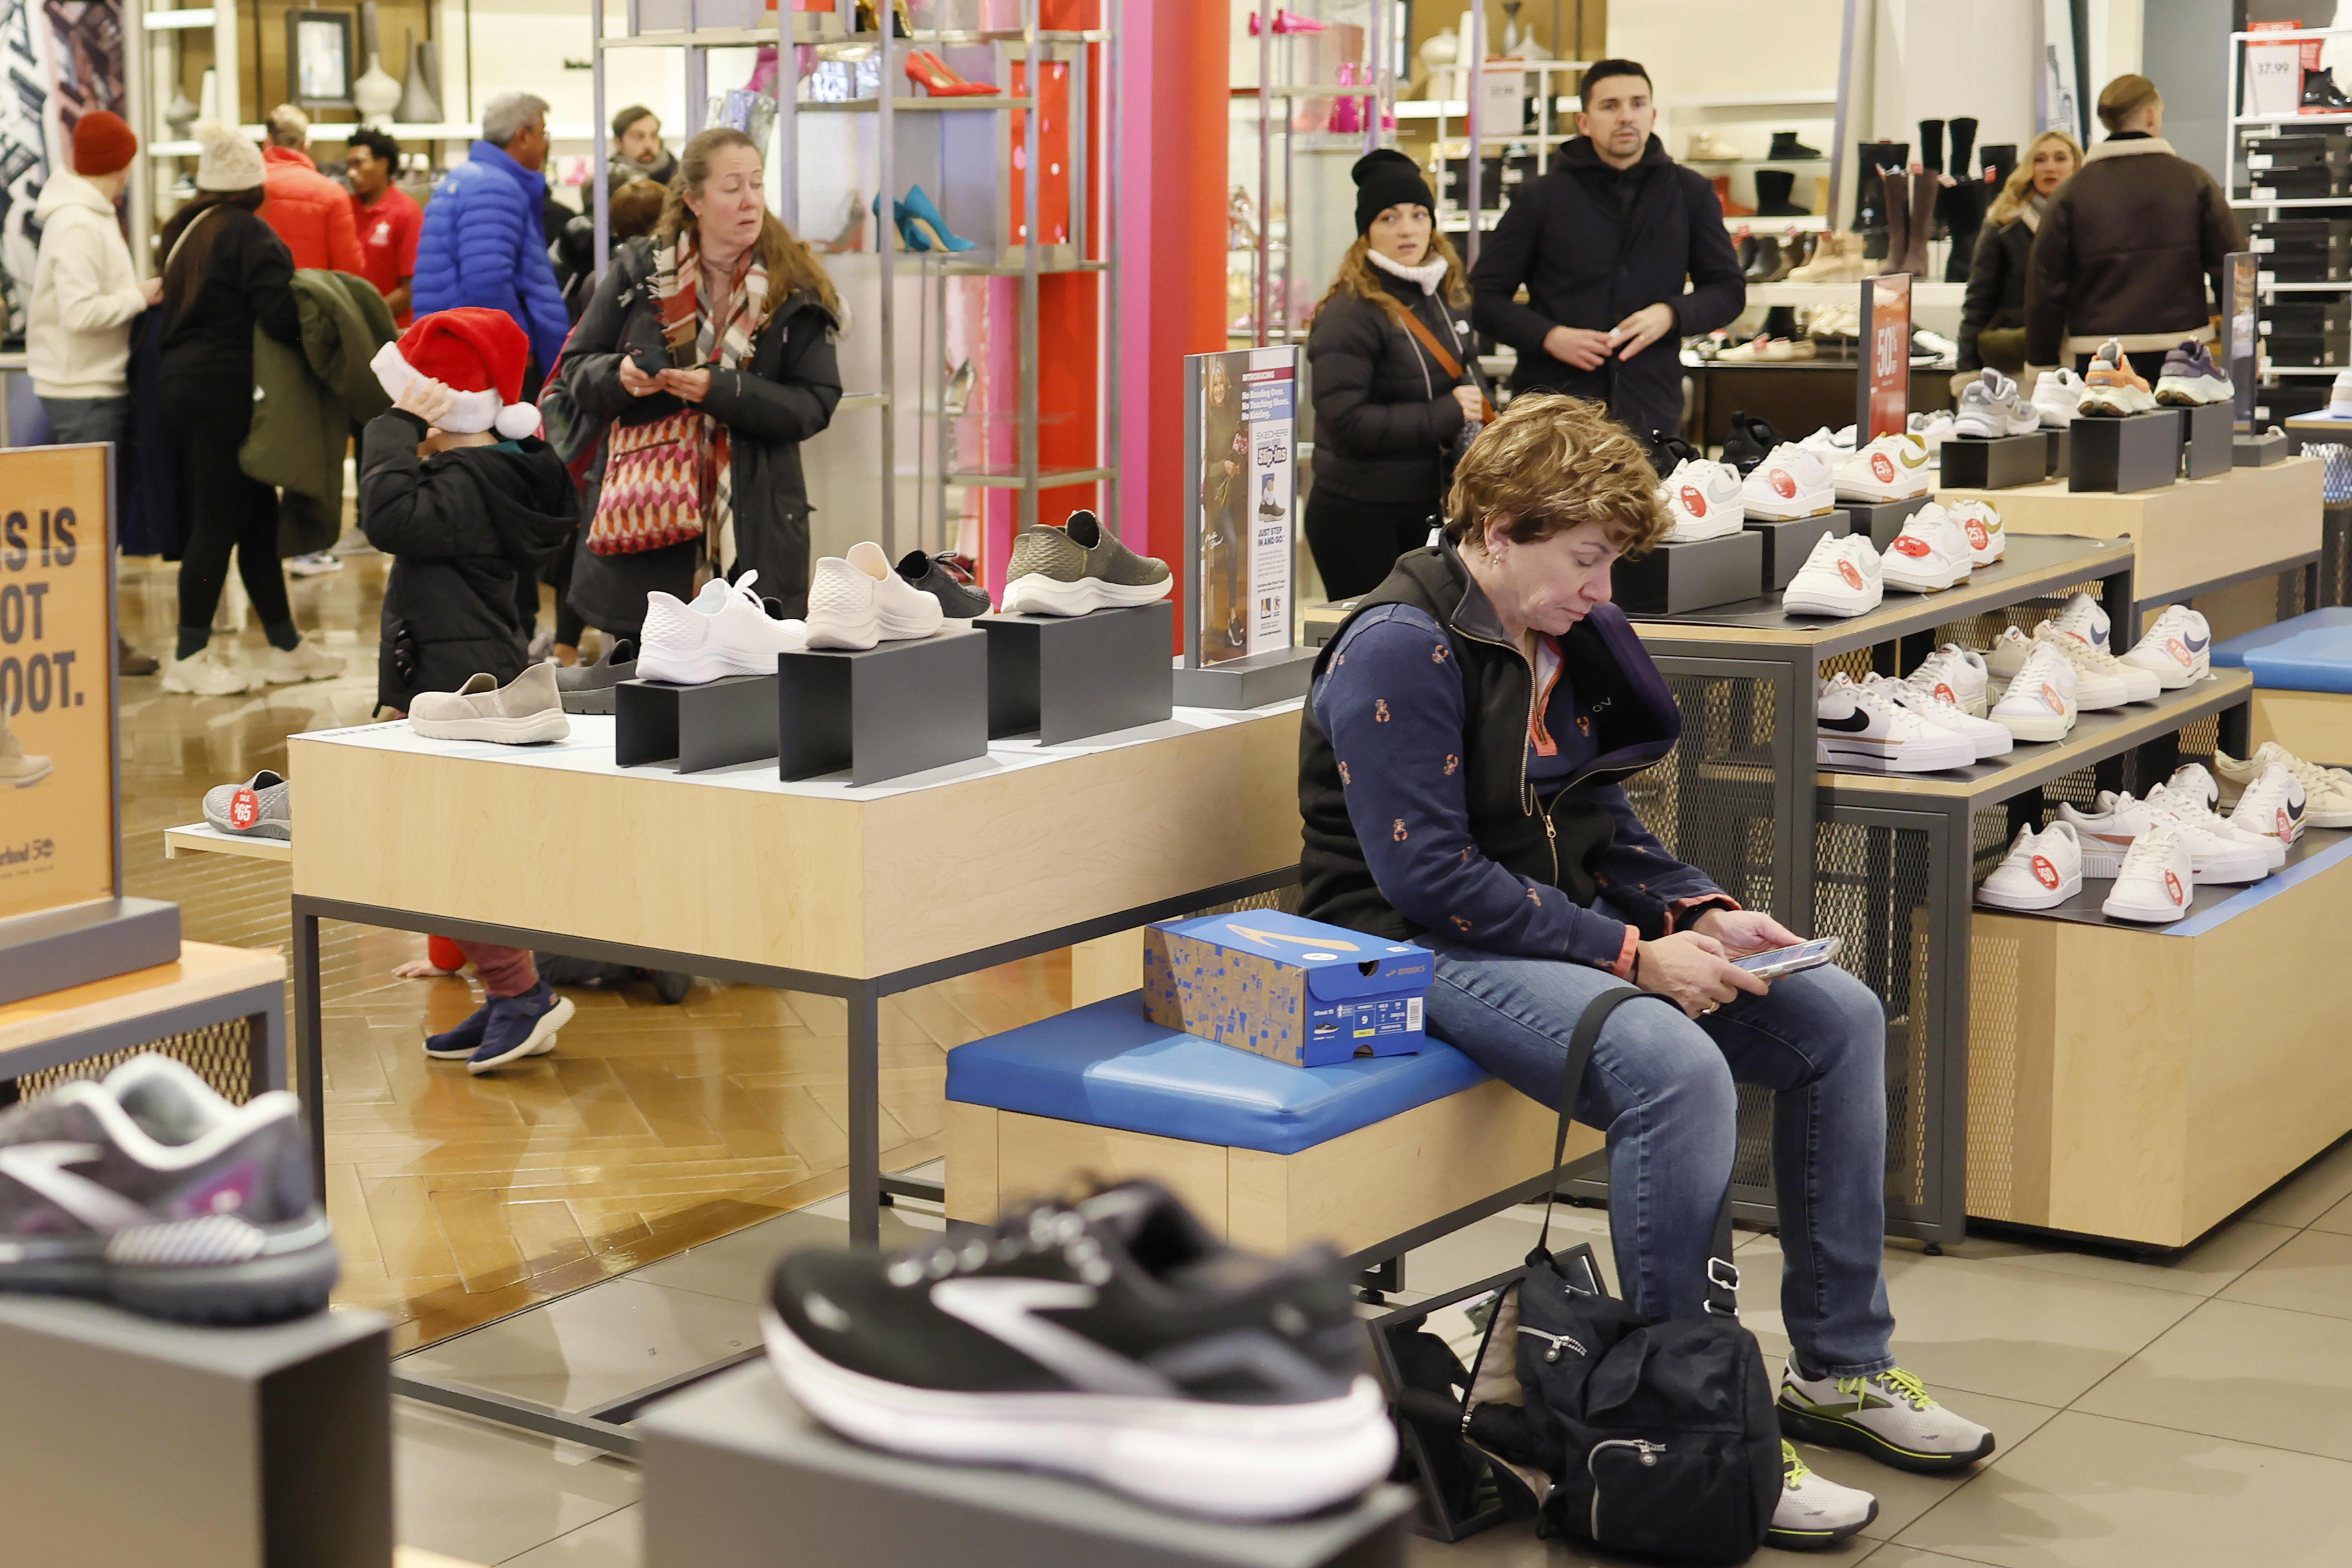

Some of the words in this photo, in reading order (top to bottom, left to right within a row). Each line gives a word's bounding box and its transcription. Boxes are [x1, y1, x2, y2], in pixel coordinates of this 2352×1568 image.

[1241, 391, 1250, 400] No
[1241, 401, 1250, 410] No
[1241, 412, 1250, 421] No
[1258, 445, 1287, 468] Slip-ins
[1258, 528, 1270, 537] JUST
[1271, 526, 1282, 535] STEP
[0, 511, 27, 571] S
[41, 508, 76, 568] IS
[1264, 537, 1274, 545] AND
[234, 802, 252, 822] $65
[1361, 1015, 1368, 1024] 9
